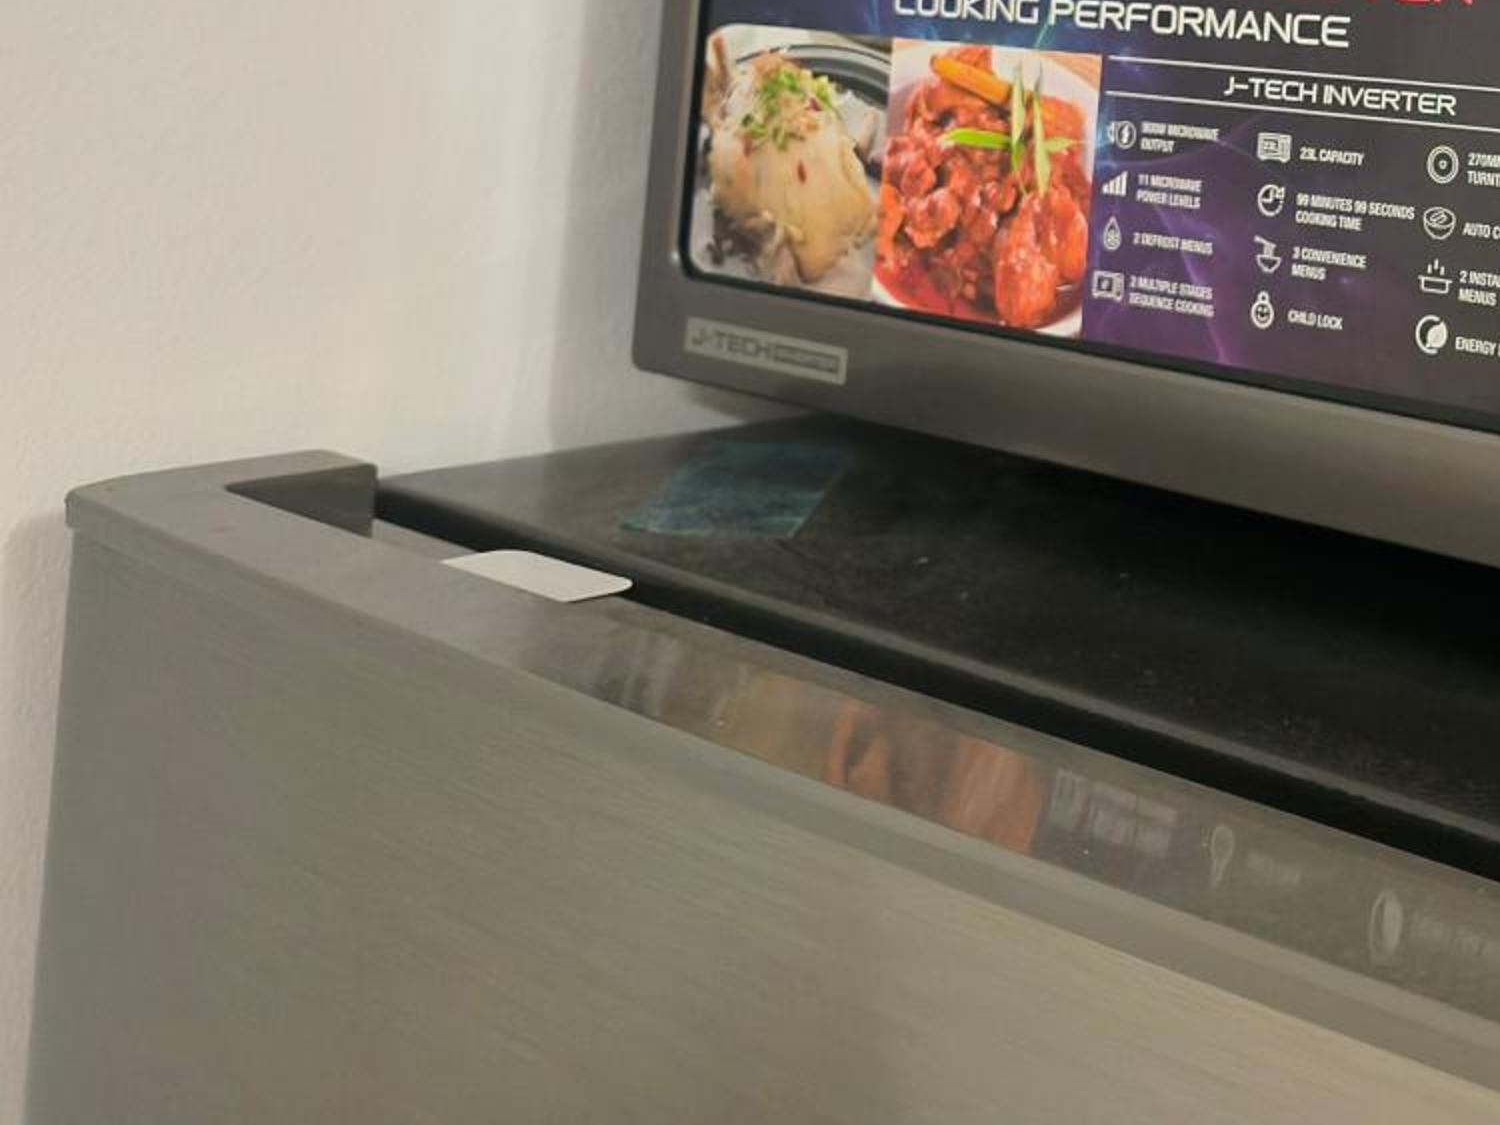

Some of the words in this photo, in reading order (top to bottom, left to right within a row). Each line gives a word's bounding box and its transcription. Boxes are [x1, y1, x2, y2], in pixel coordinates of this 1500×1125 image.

[1224, 76, 1317, 105] J-TECH
[1322, 83, 1456, 115] INVERTER
[1300, 147, 1318, 161] 23L
[1319, 149, 1365, 166] CAPACITY
[1310, 194, 1353, 211] MINUTES
[1367, 202, 1416, 220] SECONDS
[1295, 210, 1338, 227] COOKING
[1339, 215, 1363, 231] TIME
[1463, 222, 1491, 238] AUTO
[1301, 247, 1367, 269] CONVENIENCE
[1291, 263, 1327, 281] MENUS
[1460, 270, 1468, 284] 2
[1458, 288, 1497, 307] MENUS
[1288, 309, 1317, 327] CHILD
[1317, 314, 1343, 330] LOCK
[1455, 336, 1497, 356] ENERGY
